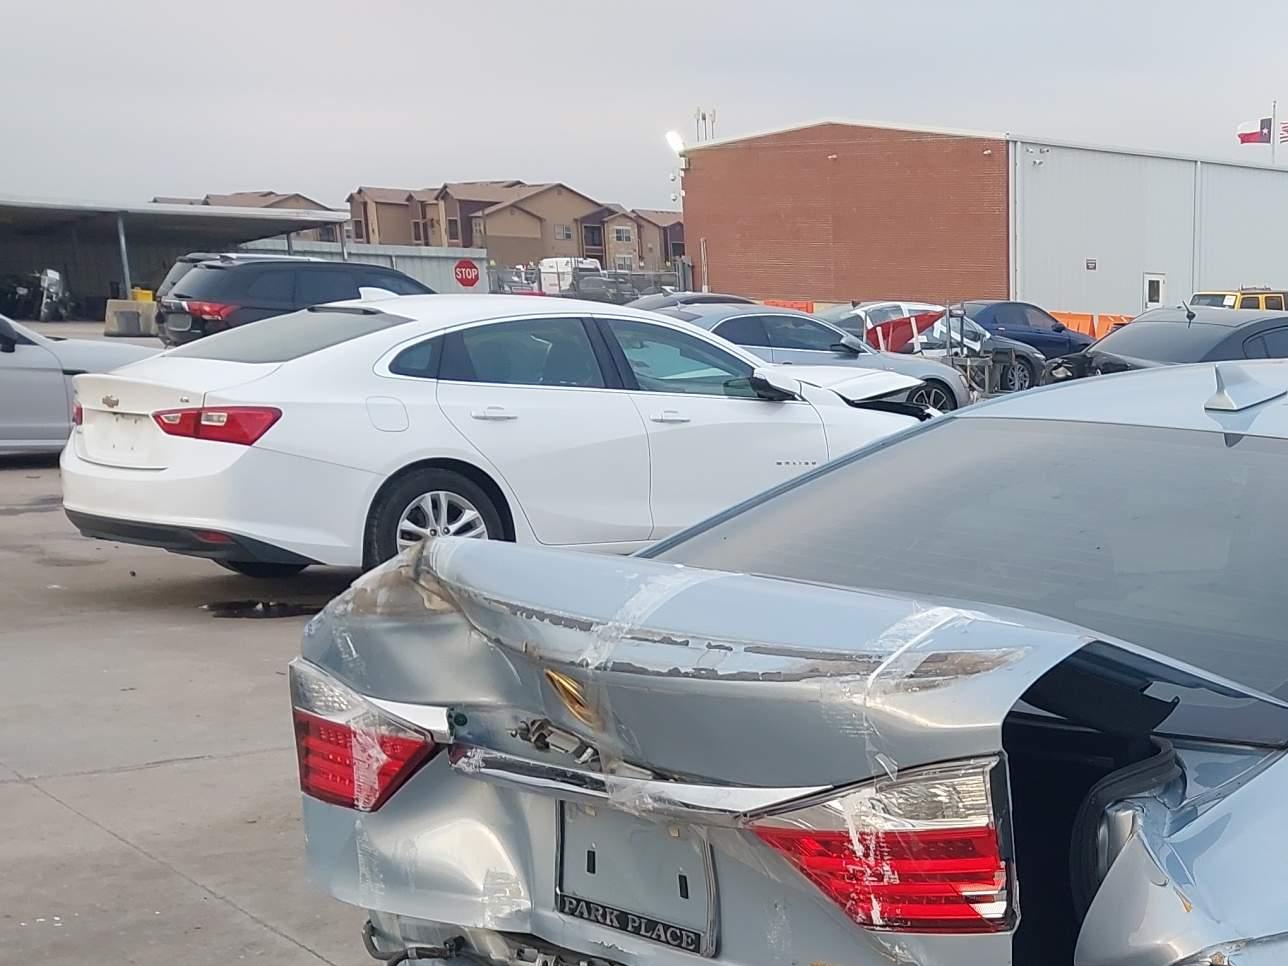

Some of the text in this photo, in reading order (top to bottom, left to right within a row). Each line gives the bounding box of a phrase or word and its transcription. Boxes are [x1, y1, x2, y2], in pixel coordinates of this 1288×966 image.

[455, 267, 478, 279] STOP
[563, 897, 697, 950] PARK PLACE
